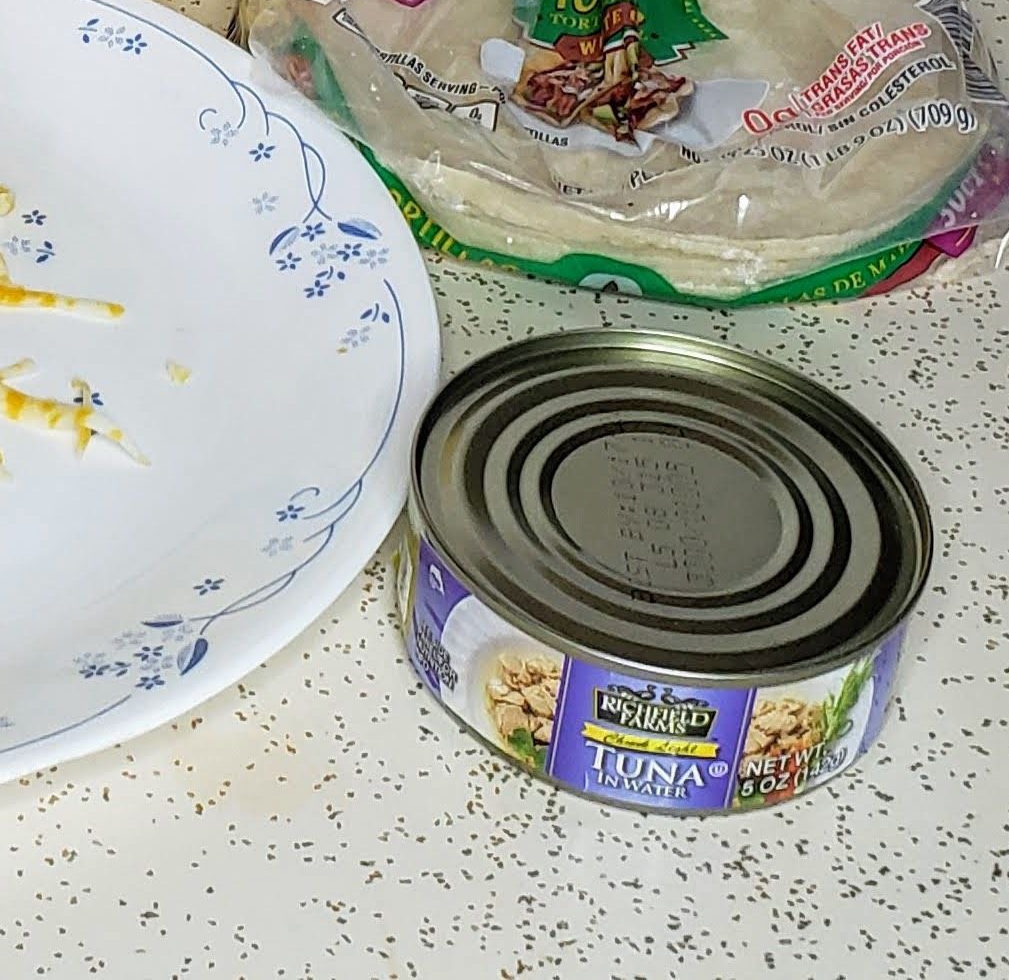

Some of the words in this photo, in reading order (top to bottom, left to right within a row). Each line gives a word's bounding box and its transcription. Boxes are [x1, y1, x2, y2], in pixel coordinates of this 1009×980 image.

[802, 52, 850, 103] TRANS
[847, 23, 884, 57] FAT/
[812, 56, 869, 114] GRASAS
[867, 23, 929, 60] TRANS
[423, 71, 478, 95] SERVING
[828, 115, 855, 132] SIN
[859, 56, 954, 118] COLESTEROL
[826, 144, 851, 162] LB
[853, 135, 866, 146] 9
[870, 117, 905, 138] OZ)
[908, 102, 952, 130] (709
[957, 106, 975, 132] g)
[600, 695, 710, 727] RICHFIELD
[620, 713, 687, 734] FARMS
[585, 740, 705, 787] TUNA
[746, 755, 791, 777] NET
[598, 770, 620, 788] IN
[622, 777, 687, 798] WATER
[741, 780, 754, 797] 5
[759, 772, 791, 794] OZ
